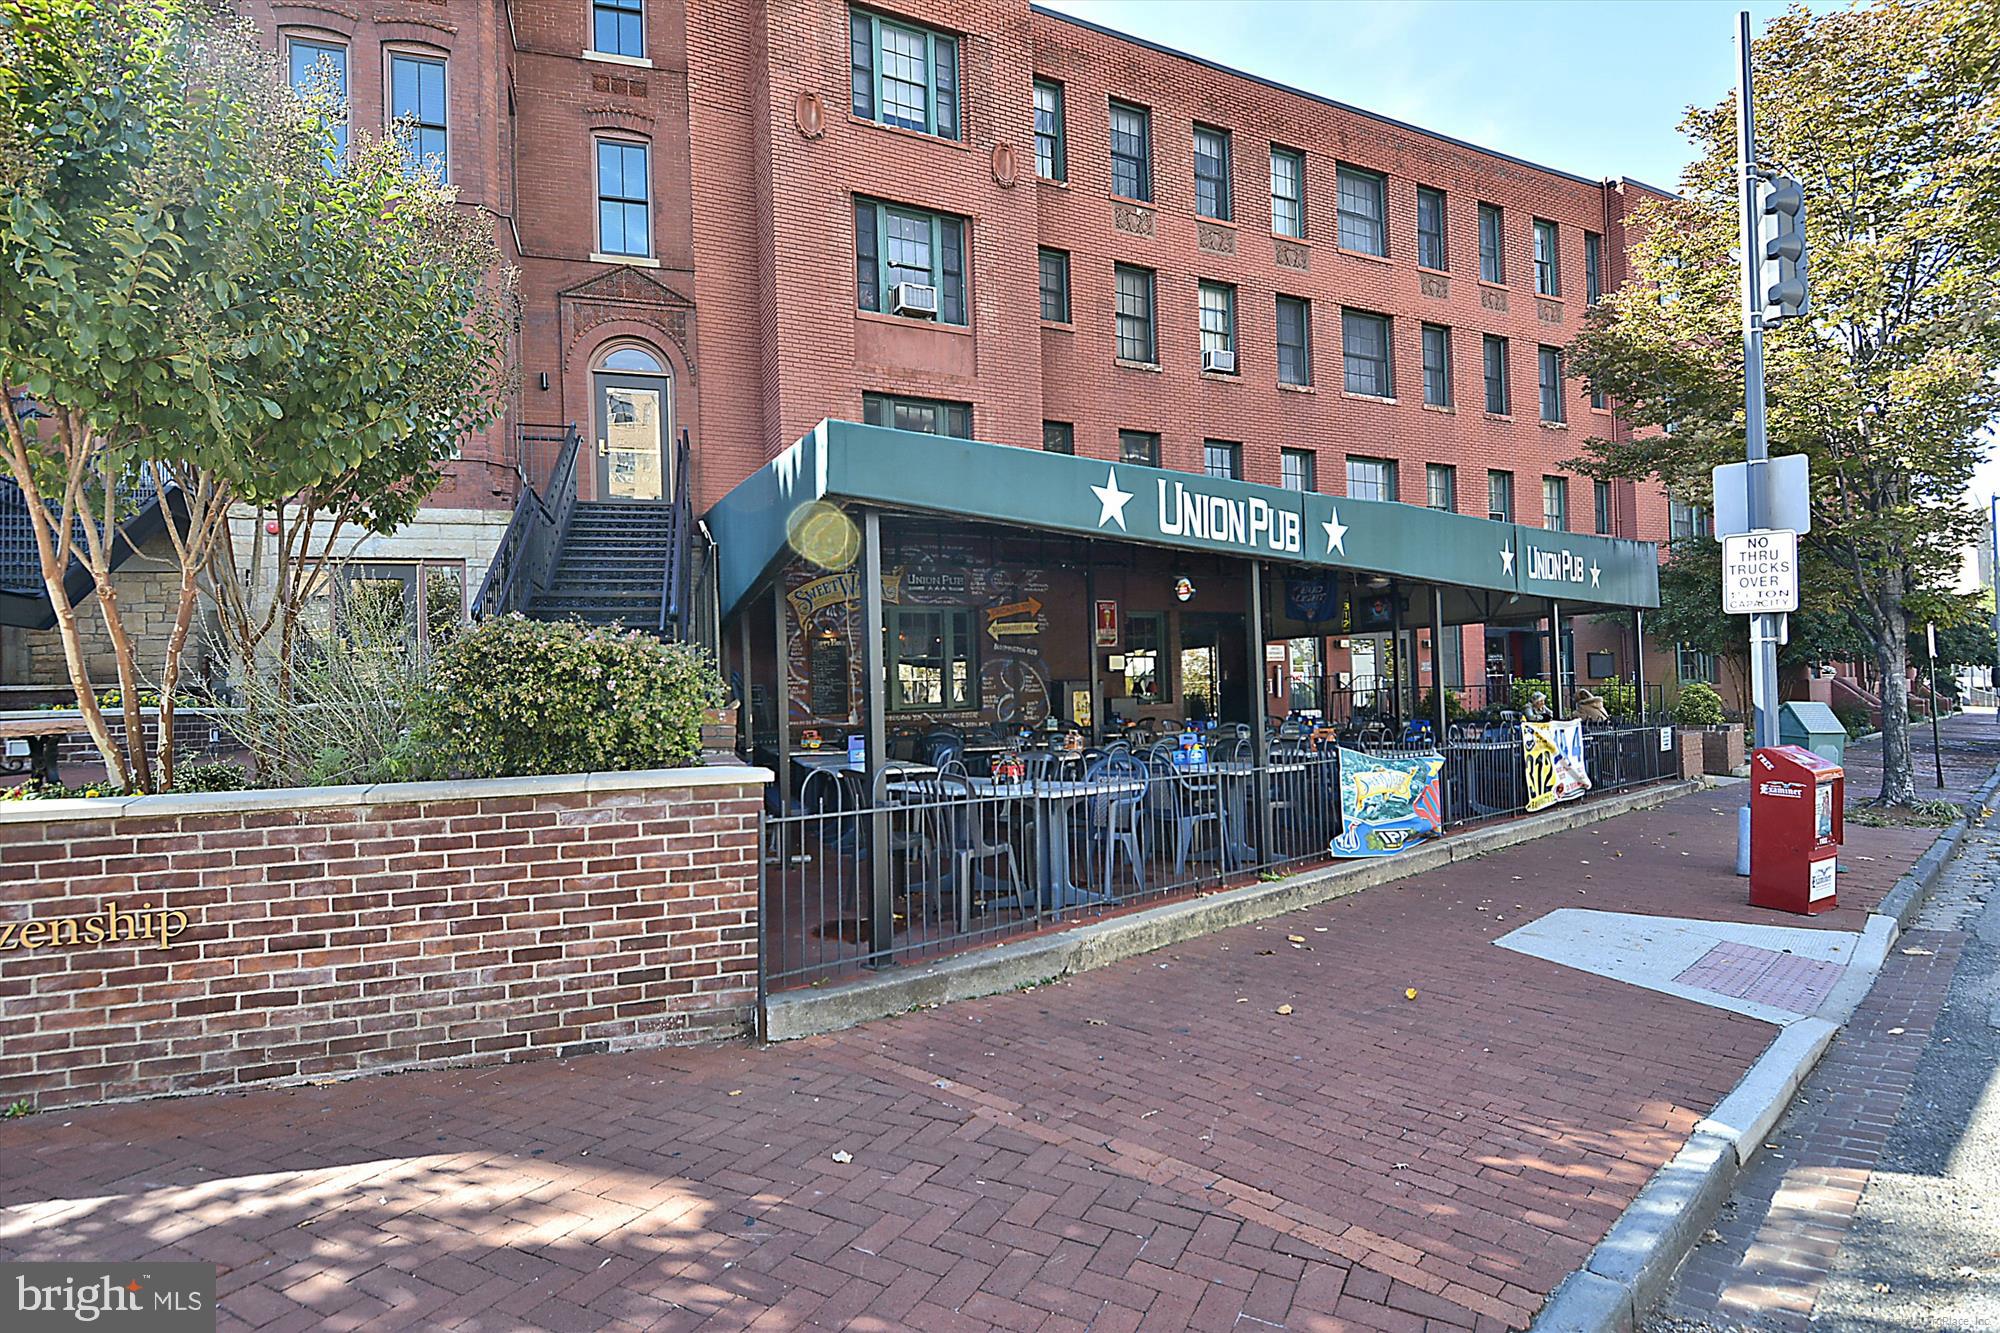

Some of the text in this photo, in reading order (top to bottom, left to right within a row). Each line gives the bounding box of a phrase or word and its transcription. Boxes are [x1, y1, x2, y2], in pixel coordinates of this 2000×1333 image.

[1157, 478, 1300, 553] UNION PUB
[1748, 537, 1768, 549] NO
[1739, 550, 1778, 562] THRU
[1527, 545, 1584, 582] UNION PUB
[1729, 561, 1790, 575] TRUCKS
[907, 574, 940, 585] UNION
[1740, 576, 1779, 588] OVER
[1758, 590, 1789, 598] TON
[1730, 599, 1789, 609] CAPACITY
[1756, 753, 1775, 770] FREE
[1526, 750, 1554, 799] 312
[1760, 783, 1803, 796] Examiner
[0, 901, 188, 950] zenship
